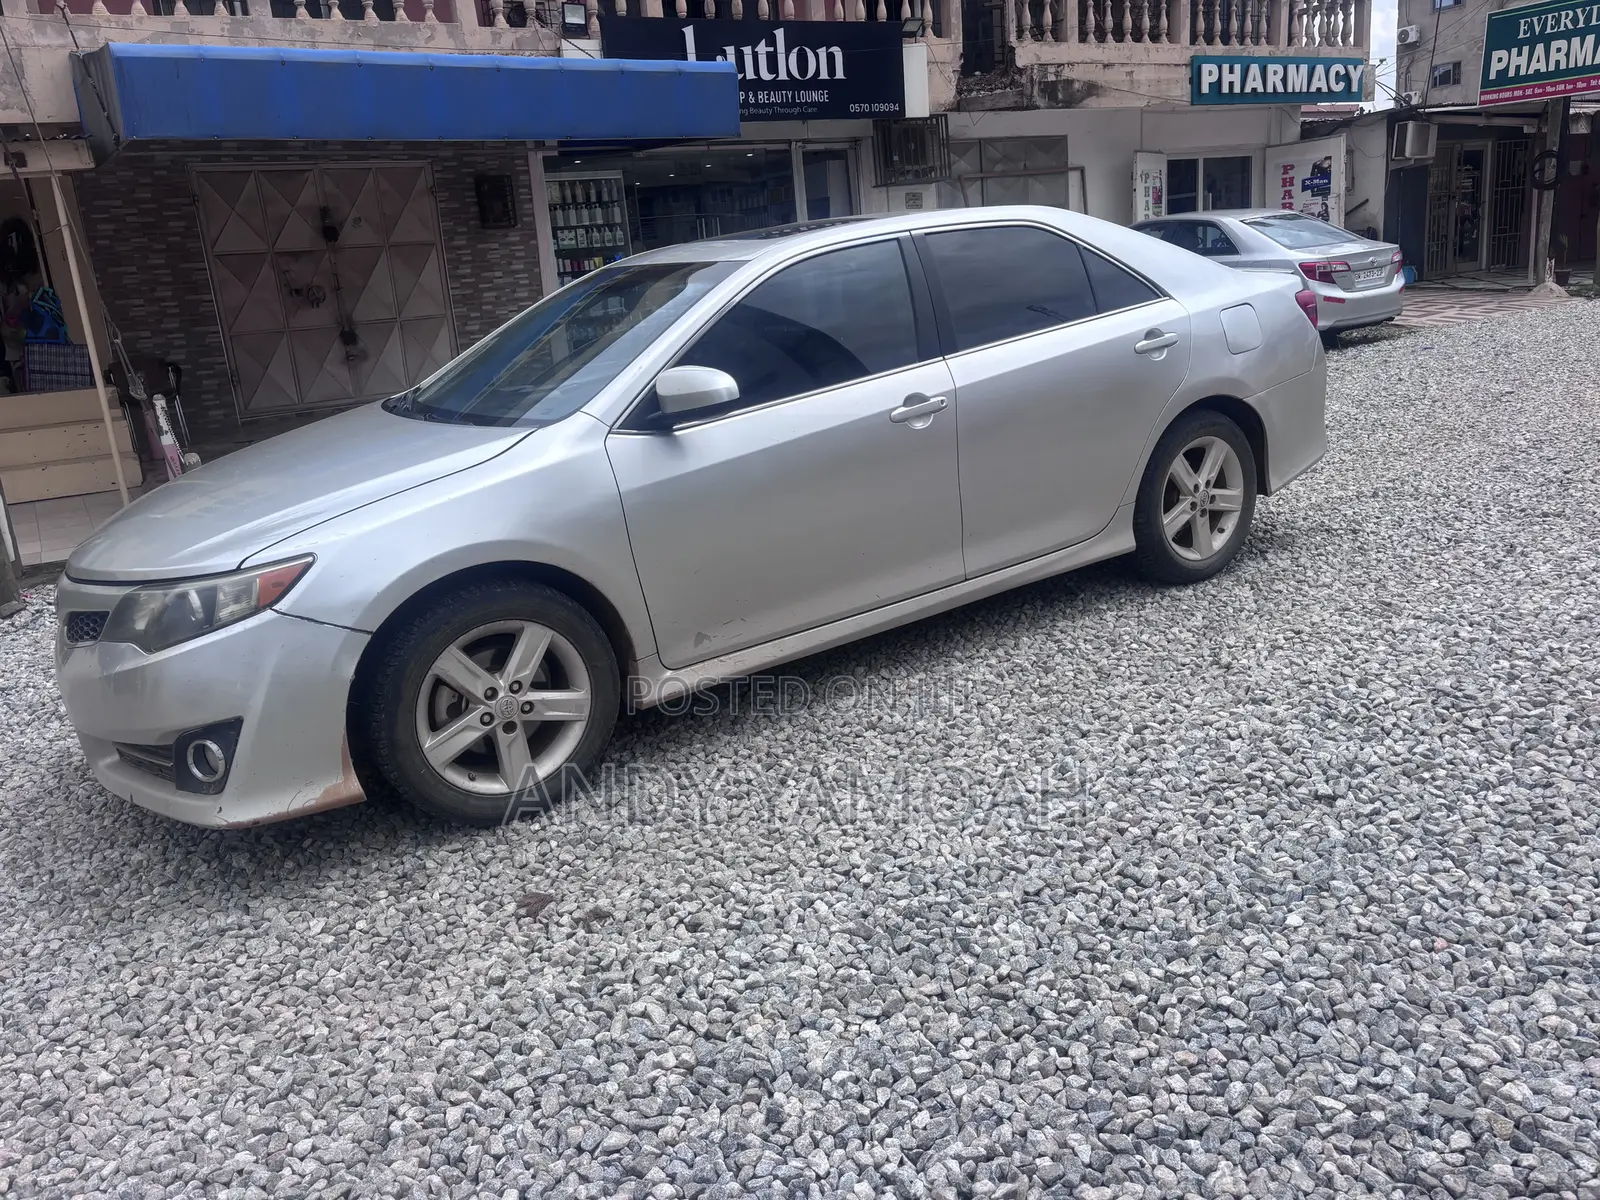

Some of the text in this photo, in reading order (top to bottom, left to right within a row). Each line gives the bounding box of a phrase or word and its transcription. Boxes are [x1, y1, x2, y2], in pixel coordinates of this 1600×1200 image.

[1200, 64, 1364, 94] PHARMACY
[748, 91, 755, 104] &
[758, 90, 792, 103] BEAUTY
[795, 90, 829, 102] LOUNGE
[749, 107, 773, 115] Beauty
[774, 106, 801, 115] Through
[849, 103, 900, 113] 0570 109094
